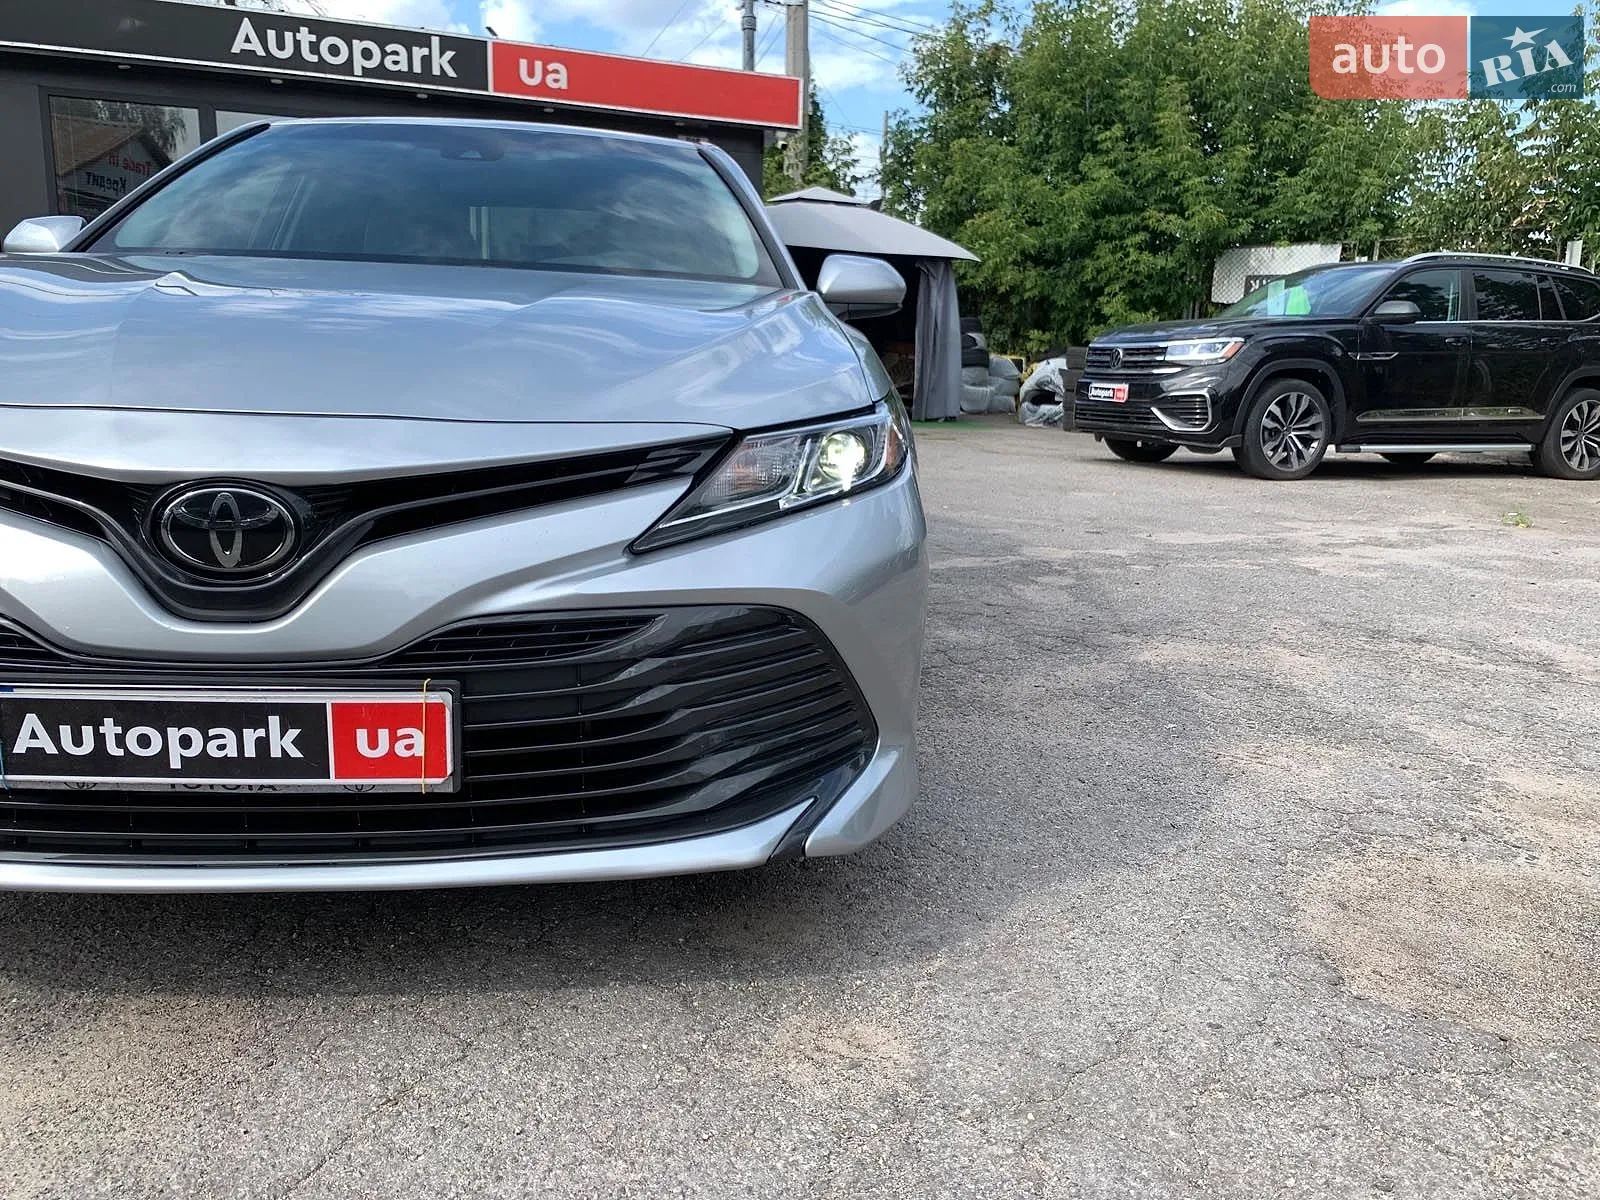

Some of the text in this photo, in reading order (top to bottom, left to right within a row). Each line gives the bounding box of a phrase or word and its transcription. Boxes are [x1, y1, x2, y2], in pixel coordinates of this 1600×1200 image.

[231, 17, 569, 90] Autopark ua
[13, 713, 424, 769] Autopark ua
